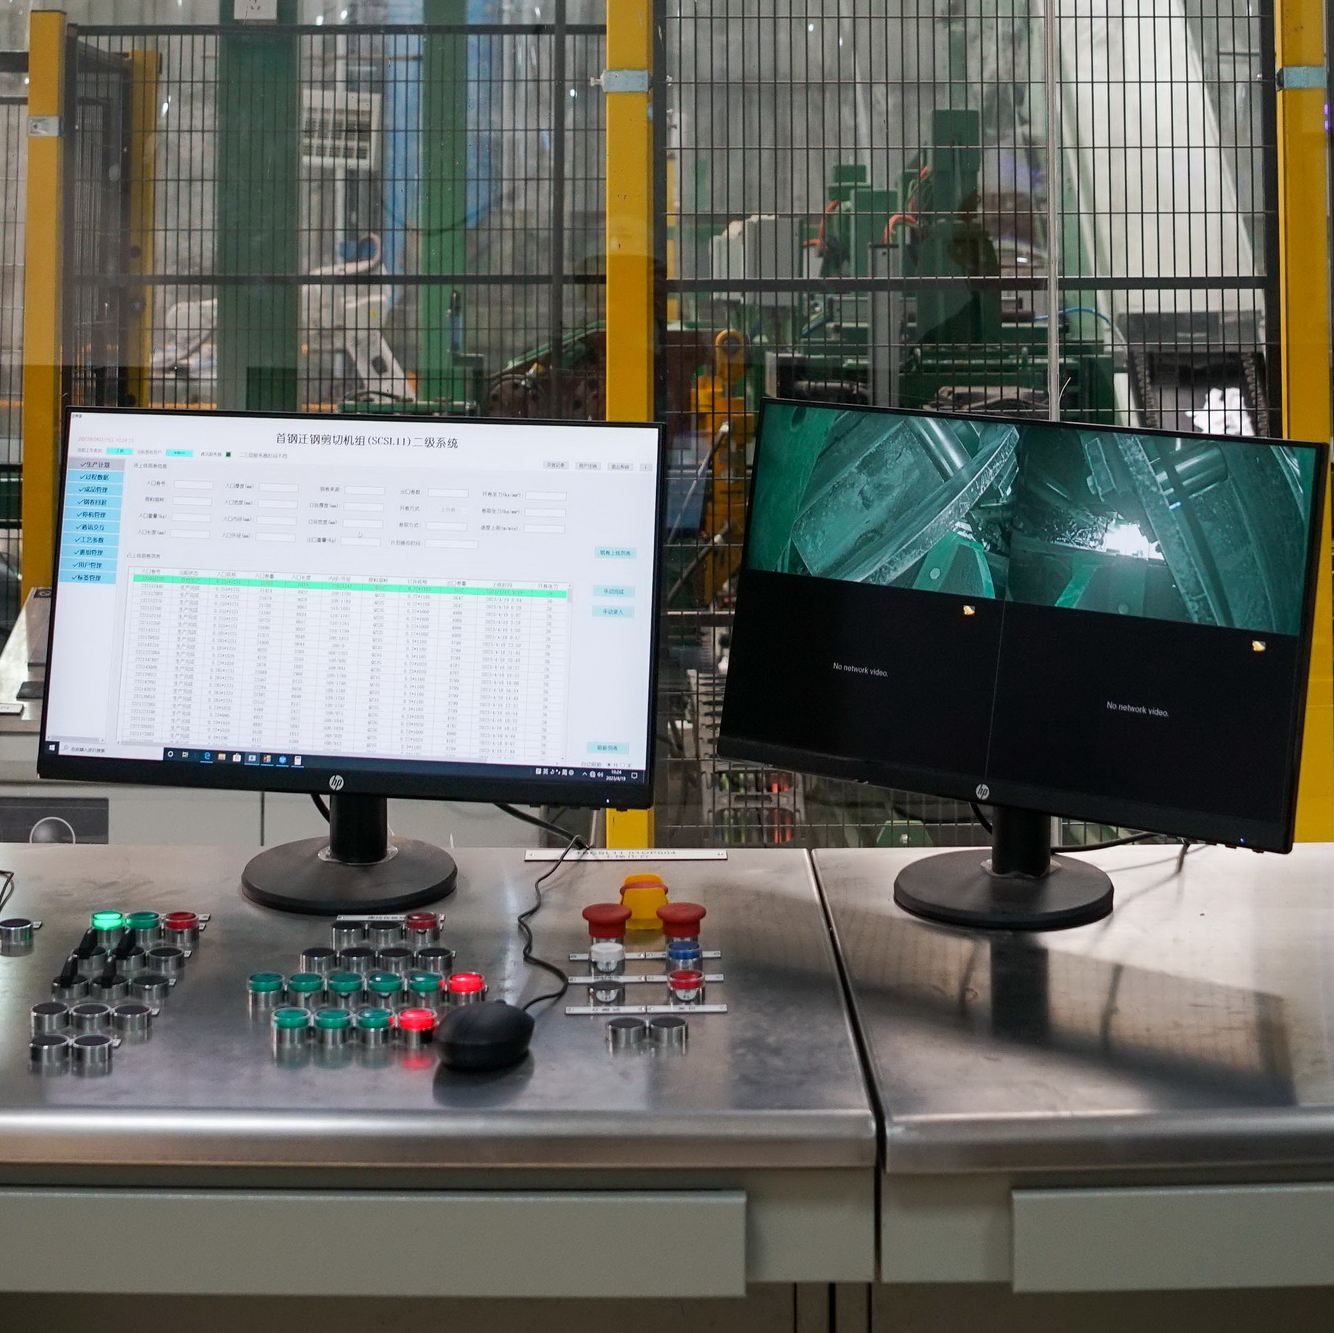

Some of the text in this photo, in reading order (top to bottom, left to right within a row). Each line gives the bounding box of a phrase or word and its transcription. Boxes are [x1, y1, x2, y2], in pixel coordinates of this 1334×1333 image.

[276, 432, 459, 449] 首钢迁钢剪切机组(SCSL11)二级系统
[833, 662, 889, 677] No network video.
[1107, 701, 1169, 717] No network video.
[329, 775, 344, 791] hp
[975, 783, 990, 800] hp
